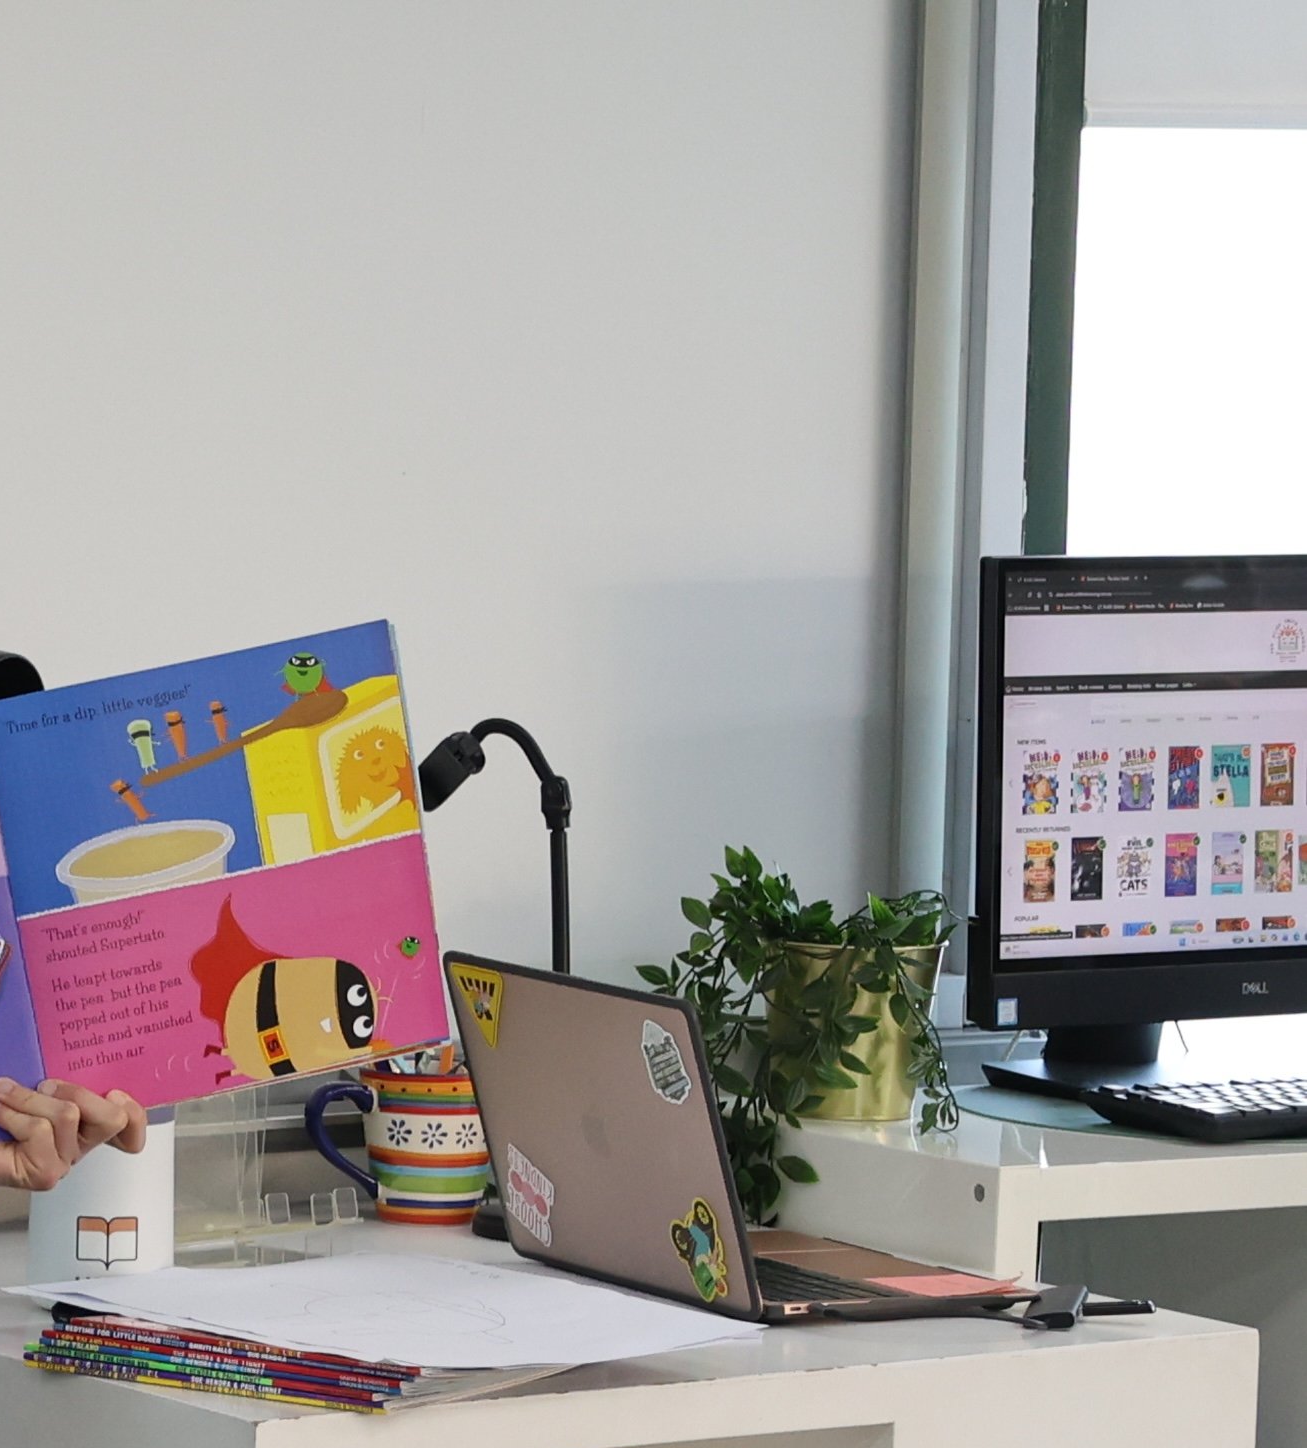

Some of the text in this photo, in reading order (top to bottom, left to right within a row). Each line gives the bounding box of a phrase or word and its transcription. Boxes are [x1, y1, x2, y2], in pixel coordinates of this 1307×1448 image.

[42, 712, 60, 728] for
[62, 714, 70, 723] a
[102, 698, 134, 715] little
[1213, 764, 1249, 778] STELLA
[1120, 879, 1148, 892] CATS
[46, 941, 98, 964] shouted
[51, 959, 163, 993] He leapt towards
[55, 998, 77, 1012] the
[110, 988, 132, 1002] but
[135, 982, 157, 996] the
[159, 976, 183, 993] pea
[1241, 981, 1269, 995] DELL
[59, 999, 169, 1035] popped out of his
[62, 1010, 194, 1052] hands and vanished
[67, 1055, 93, 1072] into
[96, 1051, 123, 1065] thin
[65, 1325, 95, 1335] BEDTIME
[97, 1329, 111, 1337] FOR
[113, 1331, 136, 1341] LITTLE
[191, 1375, 203, 1383] SUE
[206, 1377, 231, 1387] HENDRA
[241, 1383, 256, 1392] PAUL
